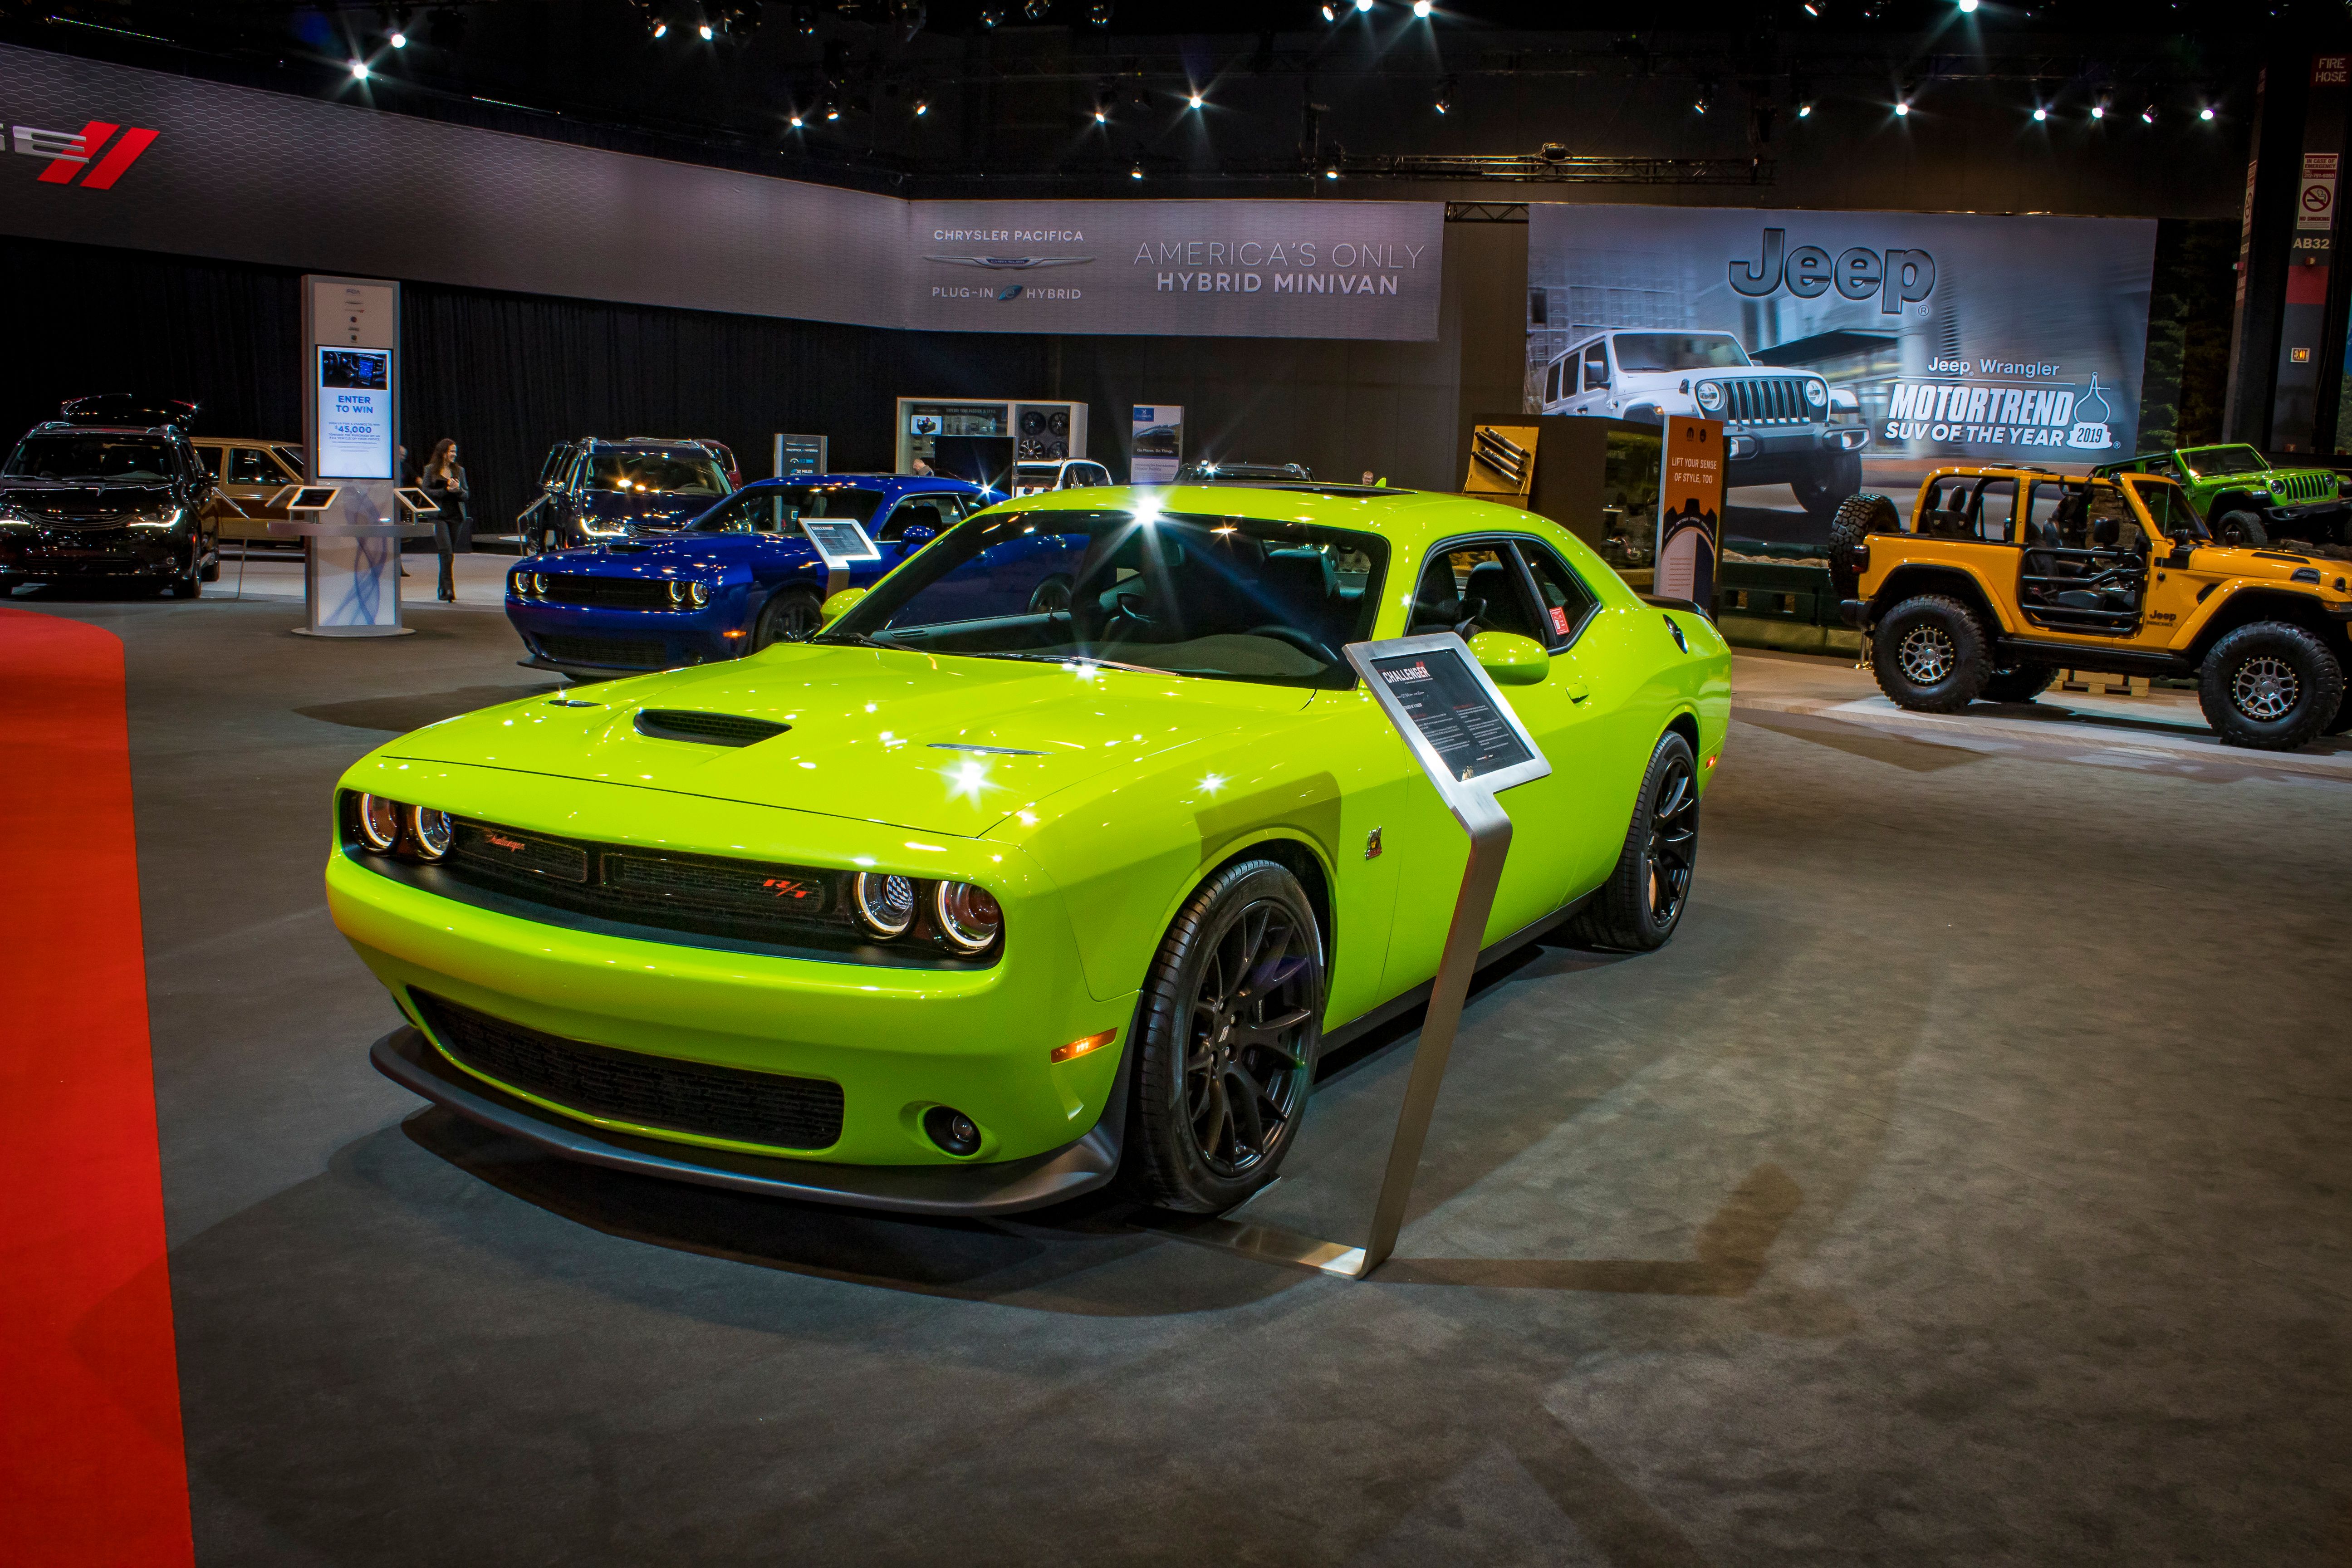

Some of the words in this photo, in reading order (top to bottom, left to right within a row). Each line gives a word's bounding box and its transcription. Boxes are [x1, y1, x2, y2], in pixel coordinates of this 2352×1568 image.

[2318, 58, 2346, 69] FIRE
[2315, 71, 2347, 82] HOSE
[0, 123, 89, 164] E
[934, 230, 1009, 241] CHRYSLER
[1014, 230, 1084, 241] PACIFICA
[2293, 238, 2330, 250] AB32
[1134, 242, 1316, 267] AMERICA'S
[1333, 244, 1424, 269] ONLY
[1729, 227, 1936, 315] Jeep
[1157, 272, 1262, 293] HYBRID
[1274, 274, 1398, 295] MINIVAN
[932, 287, 994, 299] PLUG-IN
[1026, 288, 1081, 300] HYBRID
[2293, 349, 2308, 359] EXIT
[1928, 356, 1970, 374] Jeep
[1980, 359, 2060, 378] Wrangler
[338, 395, 371, 404] ENTER
[1888, 384, 2075, 427] MOTORTREND
[336, 405, 349, 413] TO
[353, 406, 373, 414] WIN
[335, 425, 372, 434] $45,000
[1885, 421, 1930, 441] SUV
[1931, 423, 1962, 442] OF
[1966, 426, 2004, 444] THE
[2009, 427, 2064, 447] YEAR
[2076, 427, 2102, 443] 2019
[1672, 457, 1683, 466] LIFT
[1685, 458, 1699, 468] YOUR
[1700, 459, 1717, 469] SENSE
[1674, 472, 1682, 482] OF
[1683, 473, 1701, 484] STYLE,
[1703, 474, 1713, 484] TOO
[2149, 610, 2176, 622] Jeep
[1382, 666, 1431, 683] CHALLENGER
[762, 879, 813, 898] R/T
